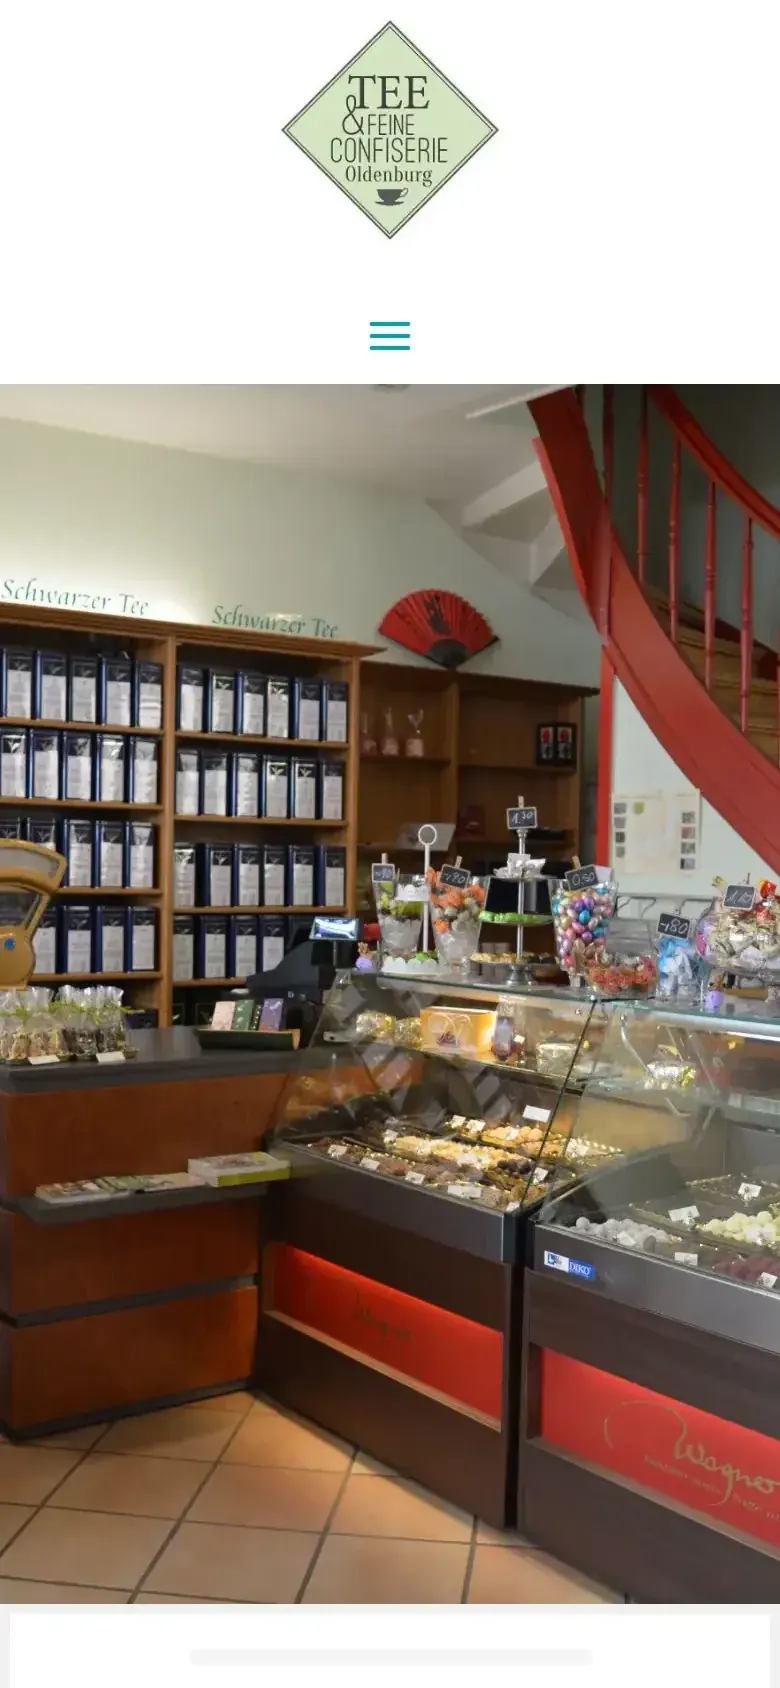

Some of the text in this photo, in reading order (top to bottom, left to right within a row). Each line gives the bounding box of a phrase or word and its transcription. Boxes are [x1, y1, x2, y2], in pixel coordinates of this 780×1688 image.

[1, 578, 149, 616] Schwarzer Tee
[211, 604, 339, 639] Schwarzer Tee
